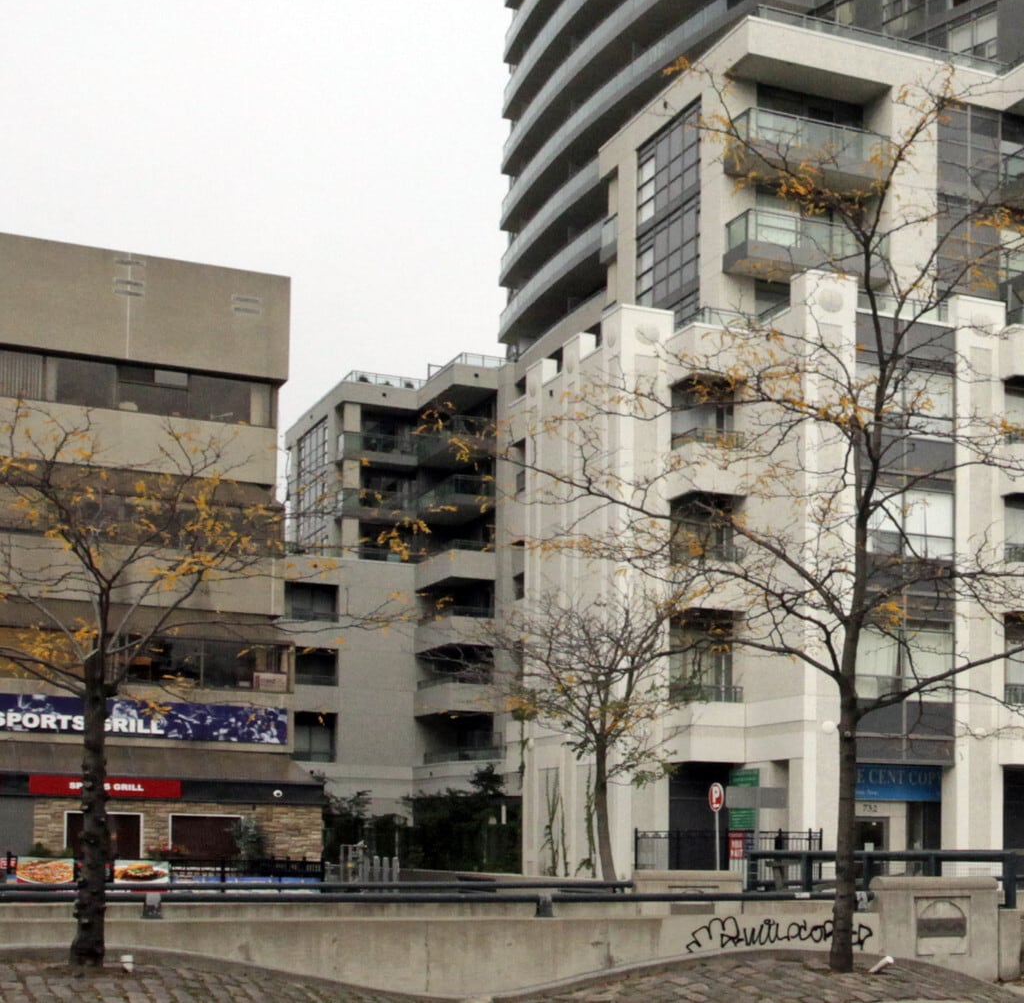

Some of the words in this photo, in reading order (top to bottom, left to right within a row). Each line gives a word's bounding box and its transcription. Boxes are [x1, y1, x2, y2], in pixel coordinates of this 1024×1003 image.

[868, 769, 904, 785] CENT
[69, 781, 111, 791] SPS
[113, 783, 144, 792] GRILL
